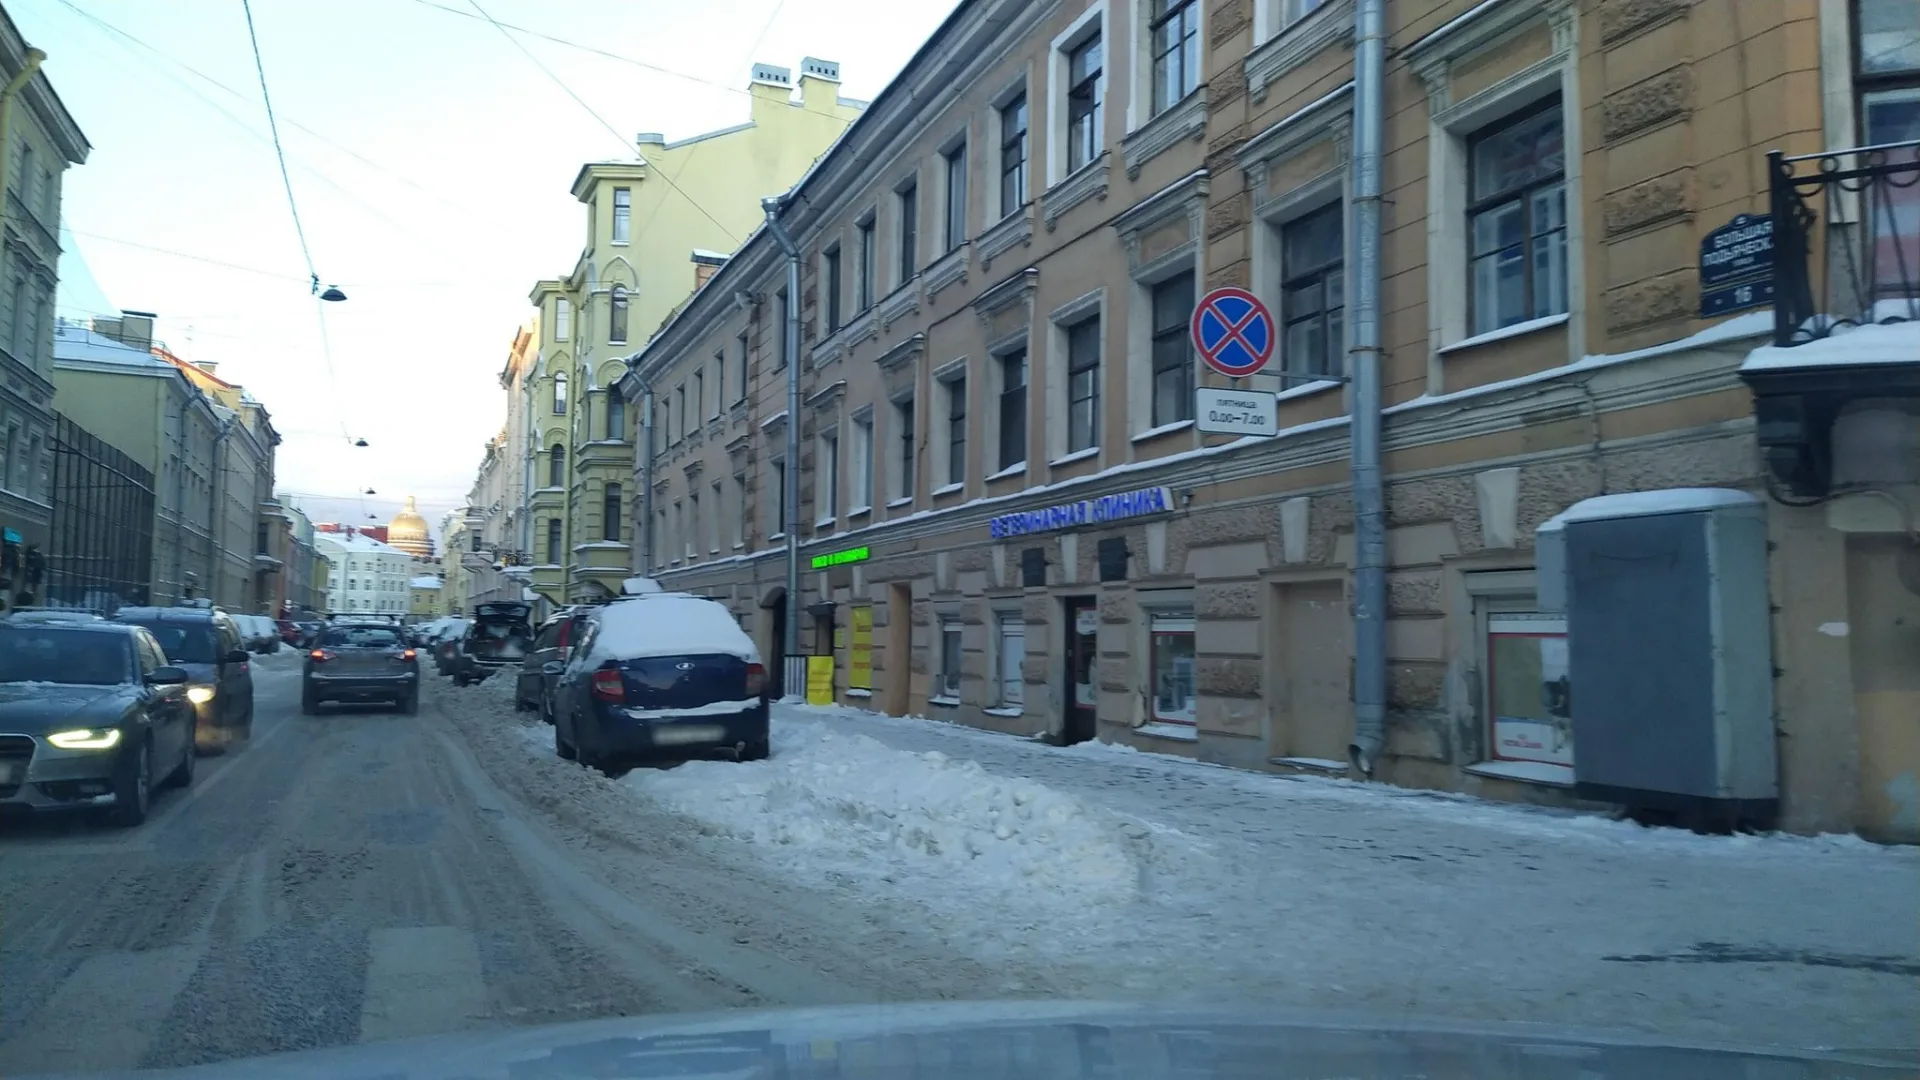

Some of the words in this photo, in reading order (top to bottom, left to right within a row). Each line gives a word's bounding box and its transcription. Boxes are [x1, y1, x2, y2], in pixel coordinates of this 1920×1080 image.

[1714, 221, 1773, 248] БОЛЬШАЯ
[1703, 237, 1774, 267] ПОДЬЯЧЕСК
[1735, 286, 1752, 304] 16
[990, 500, 1086, 539] ВЕТЕРИНАРНАЯ
[1093, 486, 1165, 522] КЛИНИКА
